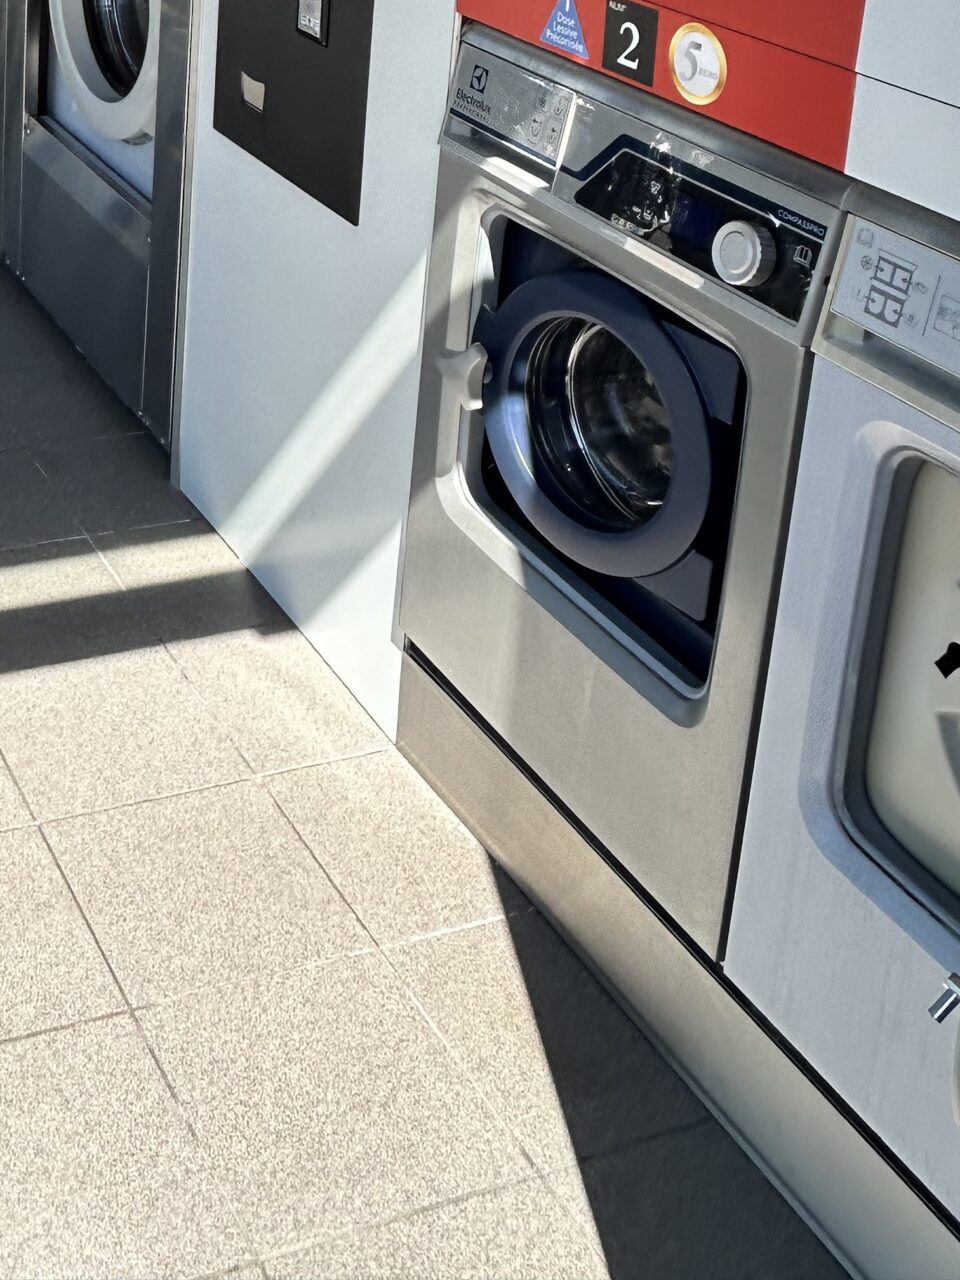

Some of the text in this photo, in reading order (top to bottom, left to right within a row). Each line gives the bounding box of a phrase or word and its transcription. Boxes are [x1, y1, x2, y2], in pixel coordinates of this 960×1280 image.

[553, 21, 578, 39] Lessive
[557, 12, 576, 26] Dose
[616, 21, 640, 70] 2
[678, 40, 702, 82] 5
[456, 87, 492, 116] Electrolux
